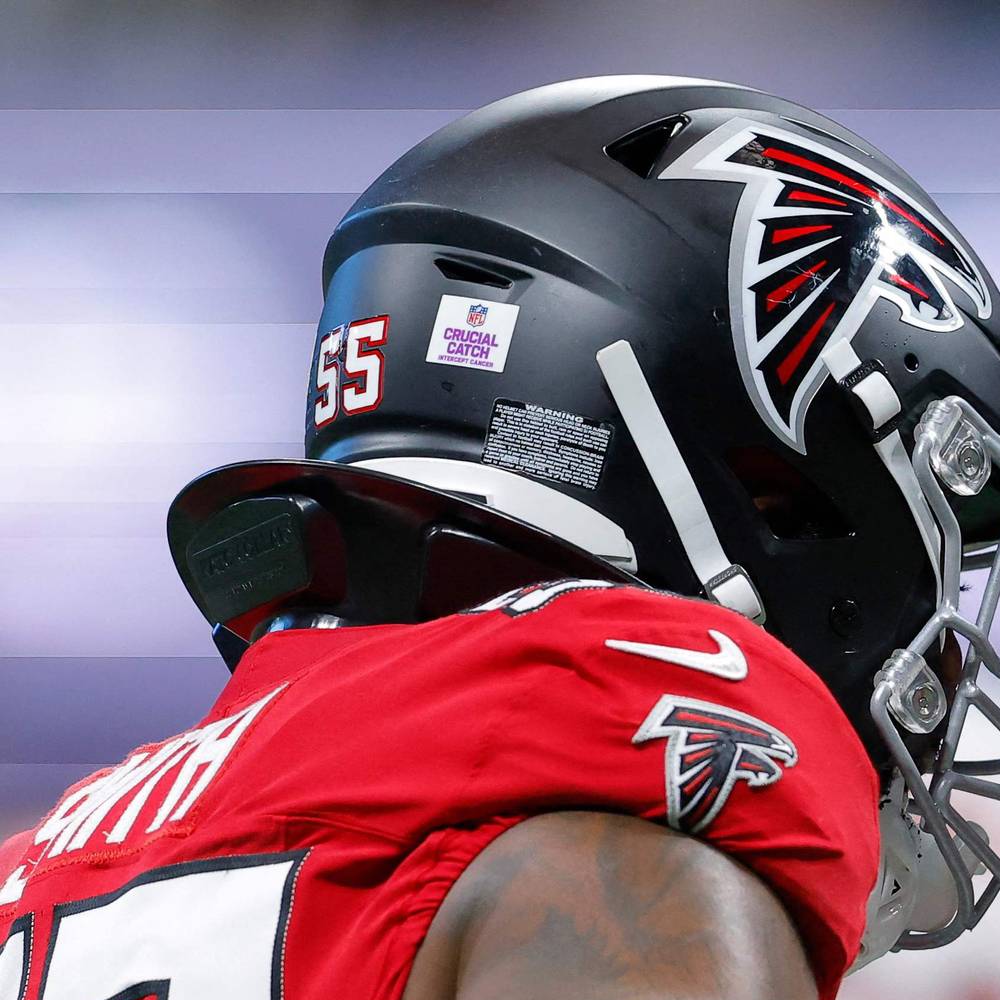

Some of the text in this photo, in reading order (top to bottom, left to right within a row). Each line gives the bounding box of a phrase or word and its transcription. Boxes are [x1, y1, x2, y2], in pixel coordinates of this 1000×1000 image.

[443, 327, 499, 348] CRUCIAL
[446, 341, 491, 360] CATCH
[314, 313, 390, 430] 55
[438, 354, 494, 369] INTERCEPT CANCER
[525, 403, 584, 424] WARNING
